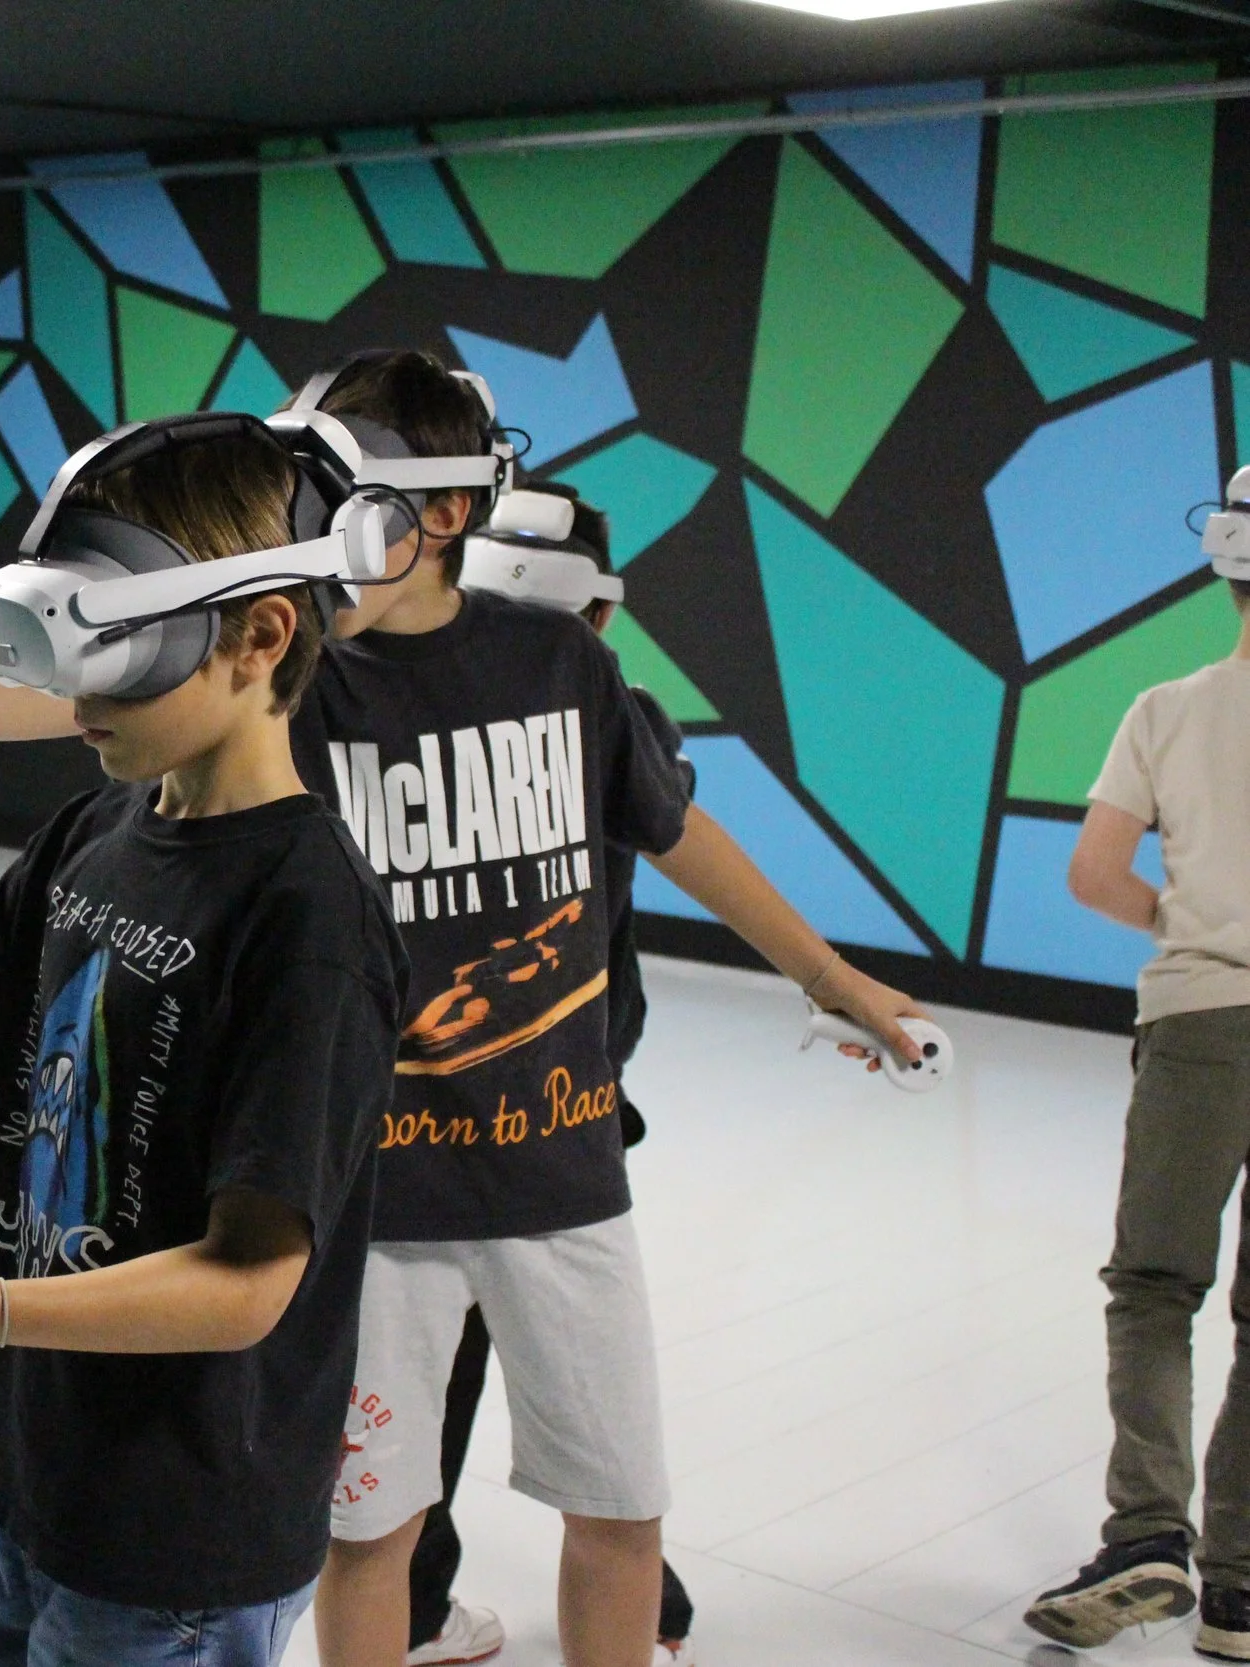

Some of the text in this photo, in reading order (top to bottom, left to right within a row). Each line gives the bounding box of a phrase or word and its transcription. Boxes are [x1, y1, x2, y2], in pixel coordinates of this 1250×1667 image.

[46, 885, 197, 979] BEACH CLOSED
[391, 872, 483, 924] MULA
[503, 865, 519, 909] 1
[150, 993, 182, 1069] AMITY
[0, 1110, 28, 1147] NO
[129, 1075, 167, 1157] POLICE
[489, 1093, 529, 1147] to
[540, 1066, 617, 1138] Race
